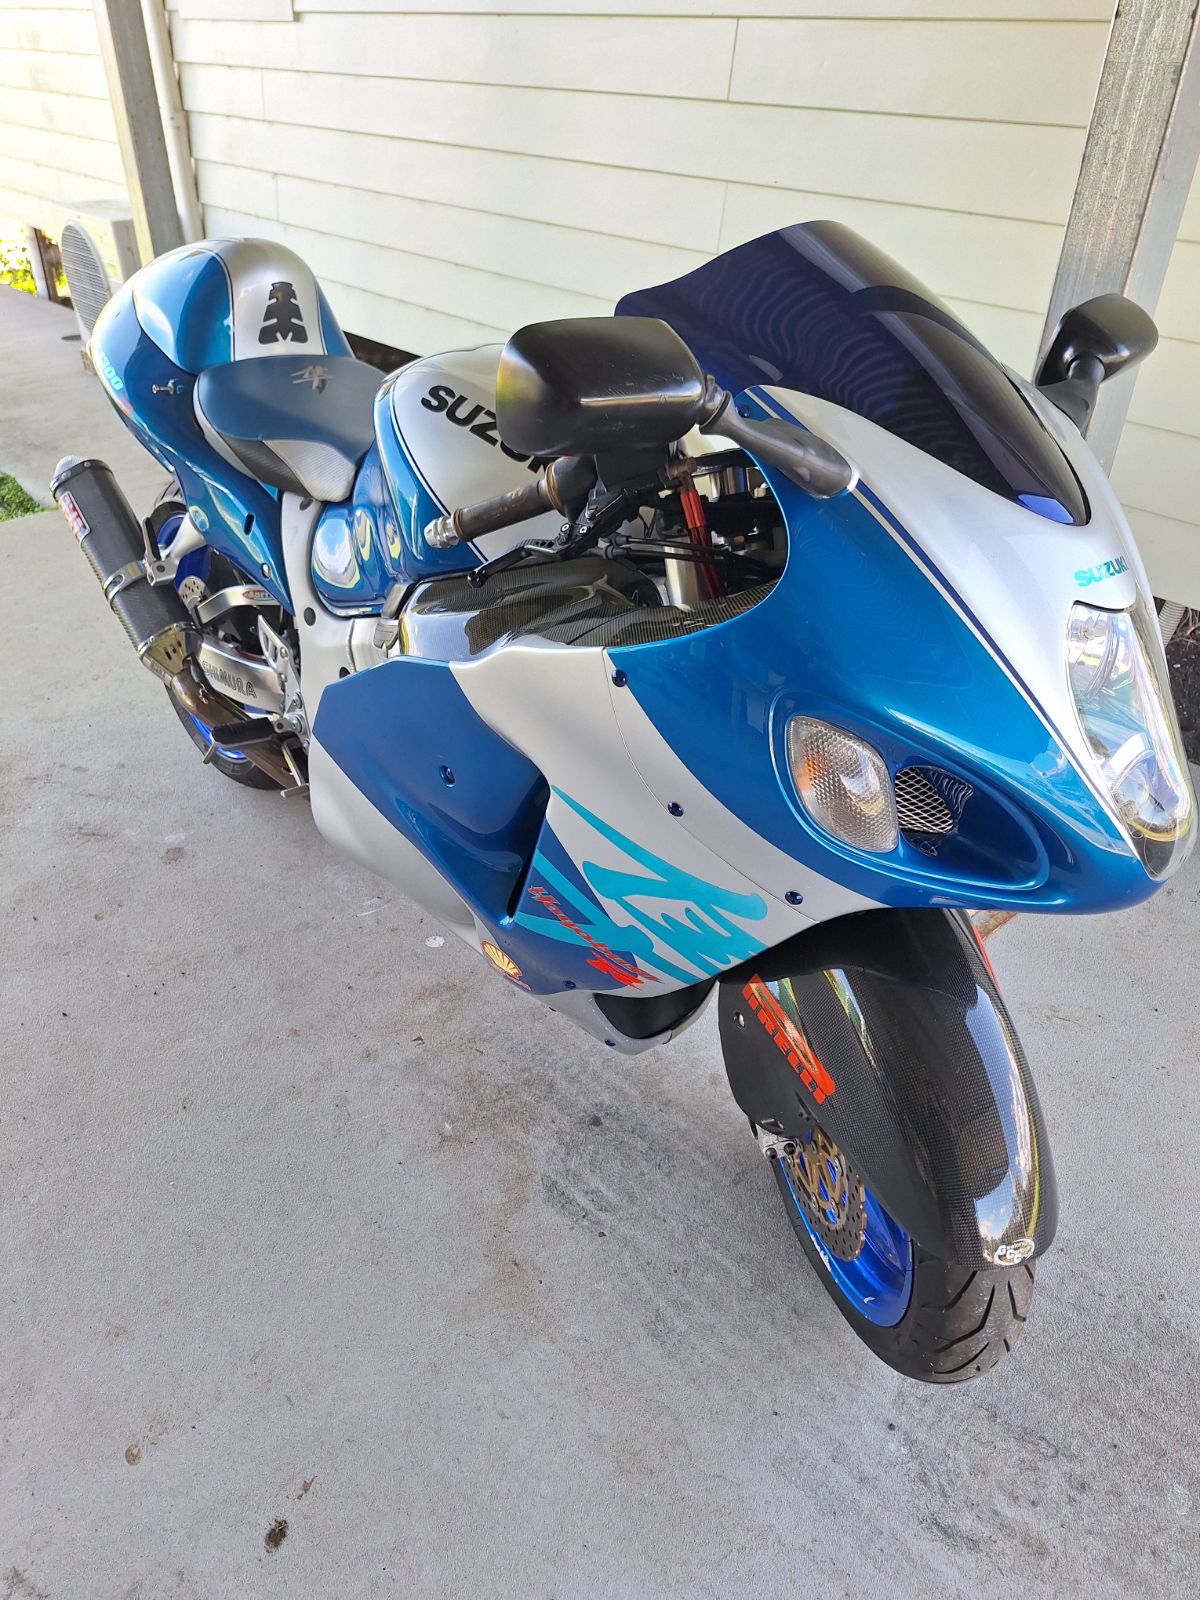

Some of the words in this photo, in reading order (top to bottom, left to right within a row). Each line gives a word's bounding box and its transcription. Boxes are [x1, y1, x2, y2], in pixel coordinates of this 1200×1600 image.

[1073, 556, 1128, 588] SUZUKI
[527, 884, 665, 984] Hayabusa
[741, 973, 836, 1105] PIRELLI
